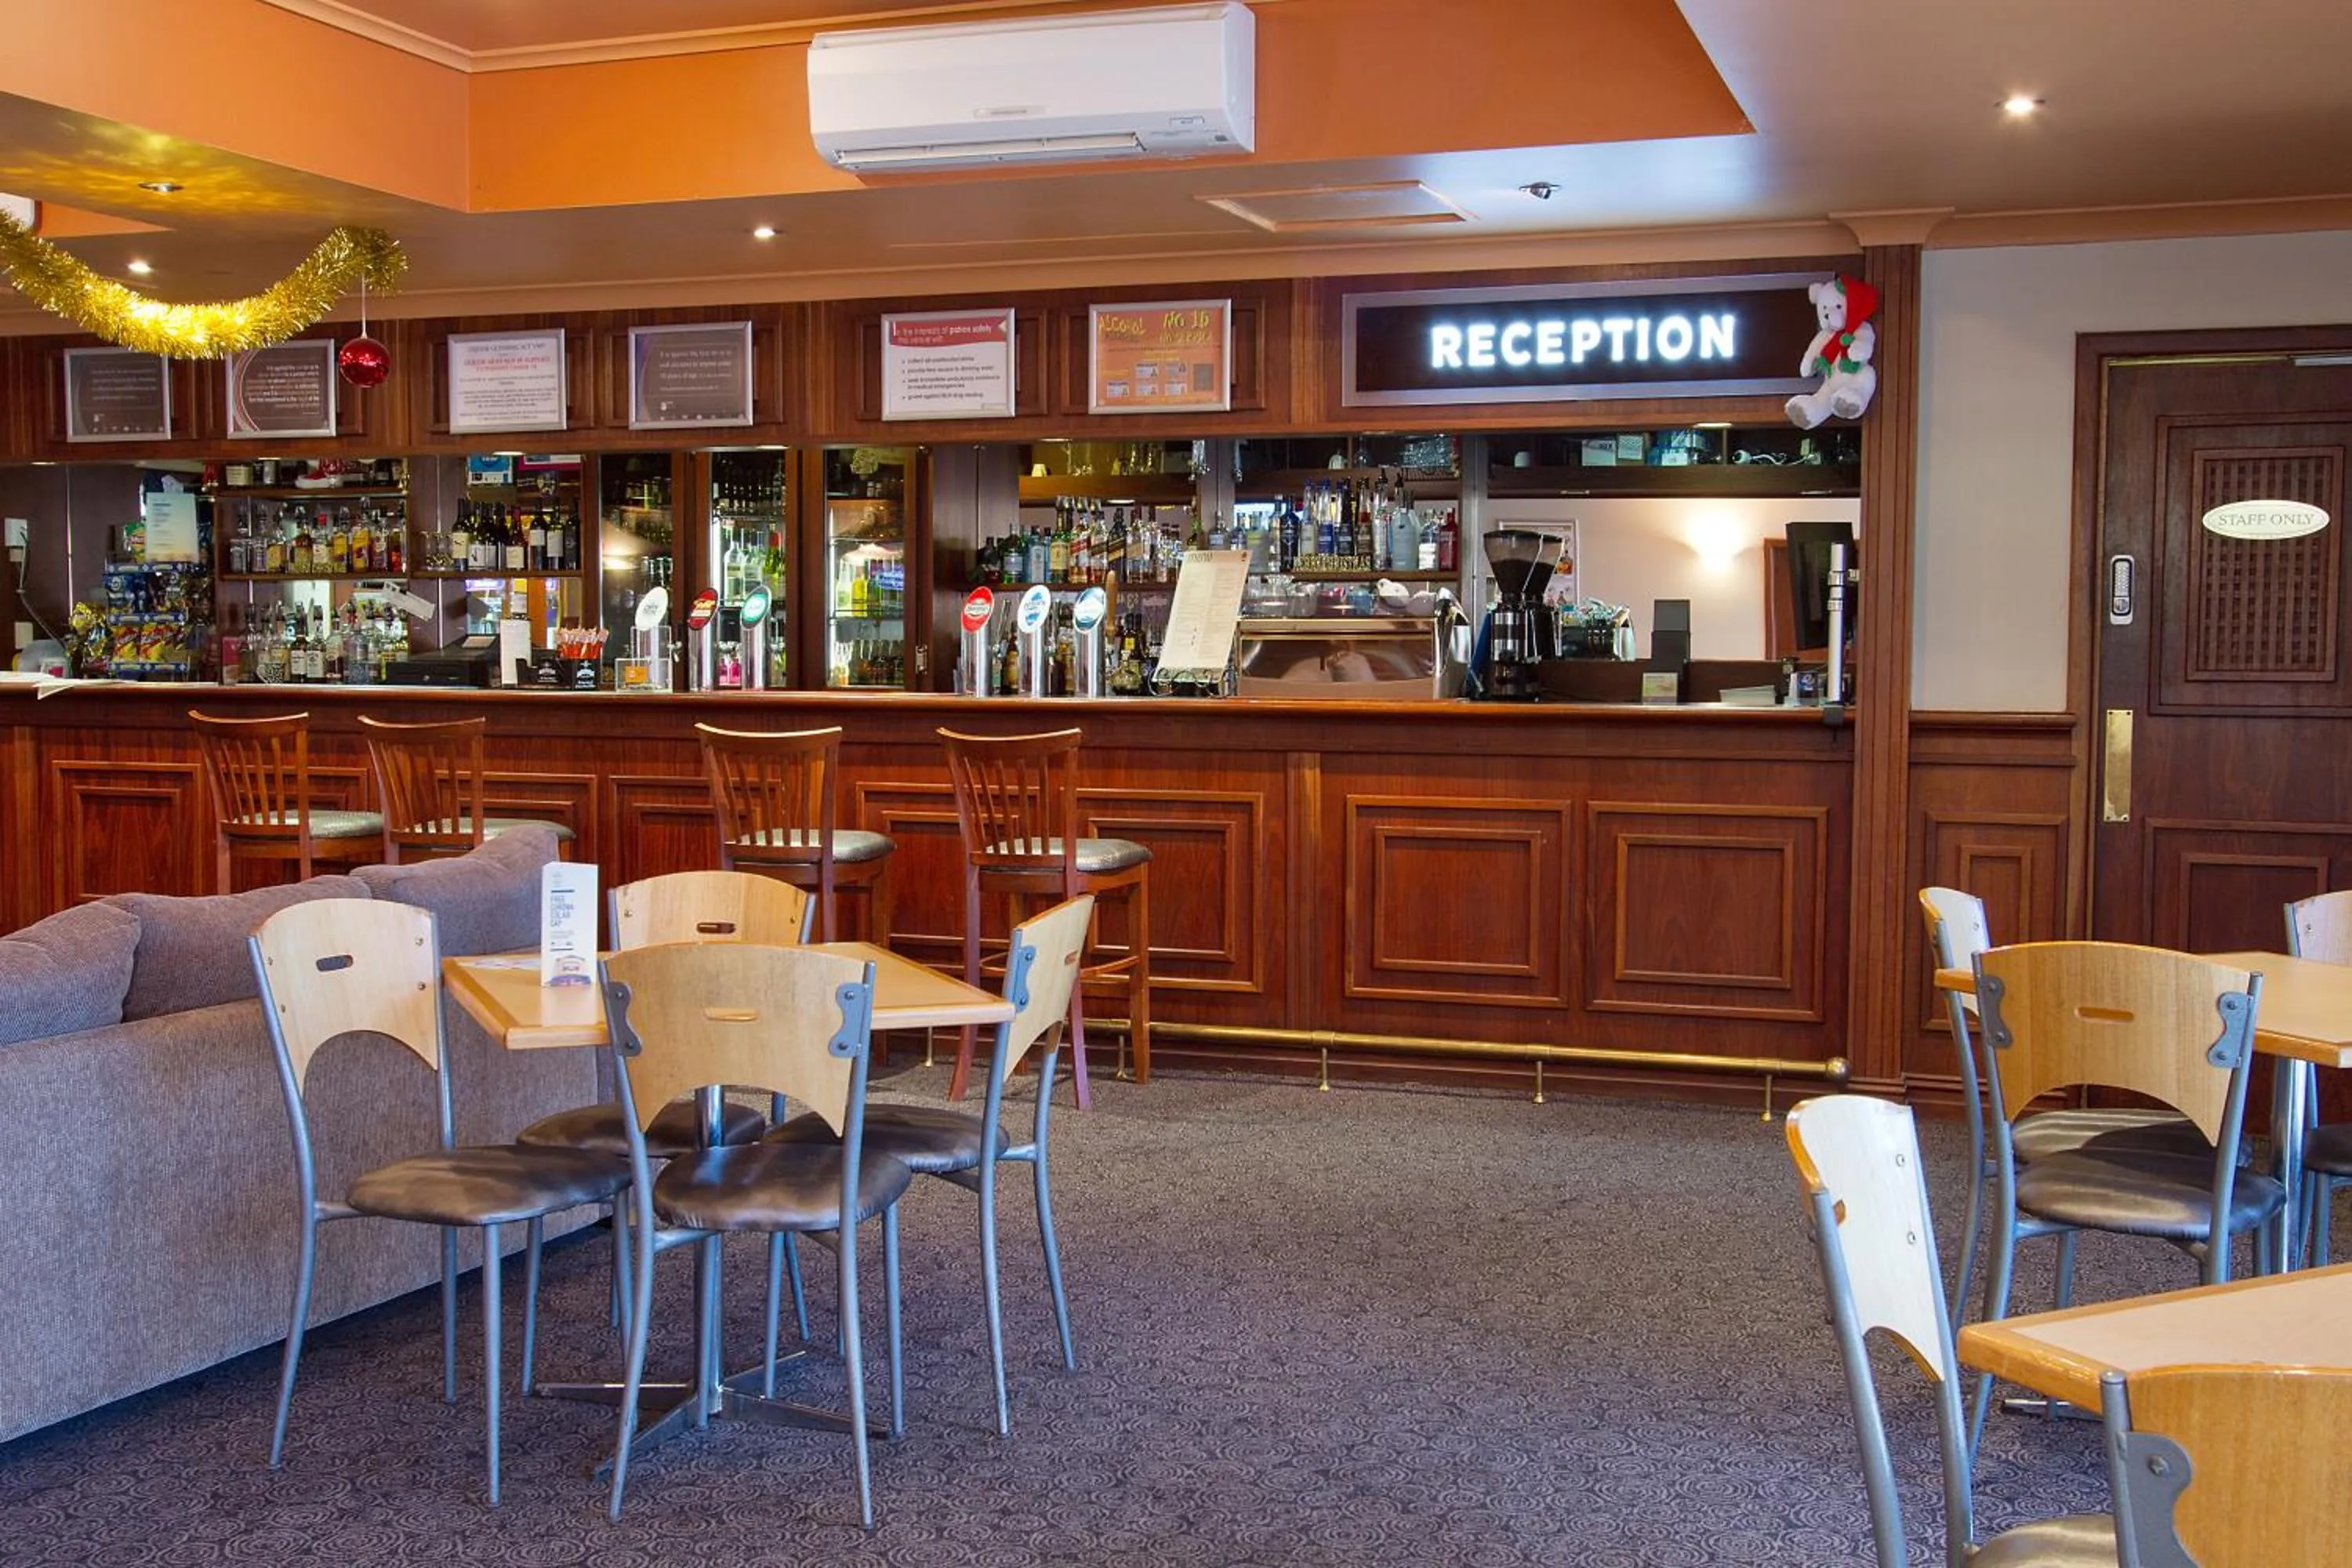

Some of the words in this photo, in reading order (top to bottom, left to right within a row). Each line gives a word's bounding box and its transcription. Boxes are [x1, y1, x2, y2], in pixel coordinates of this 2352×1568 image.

[1430, 314, 1736, 369] RECEPTION
[2218, 514, 2267, 526] STAFF
[2270, 513, 2315, 526] ONLY
